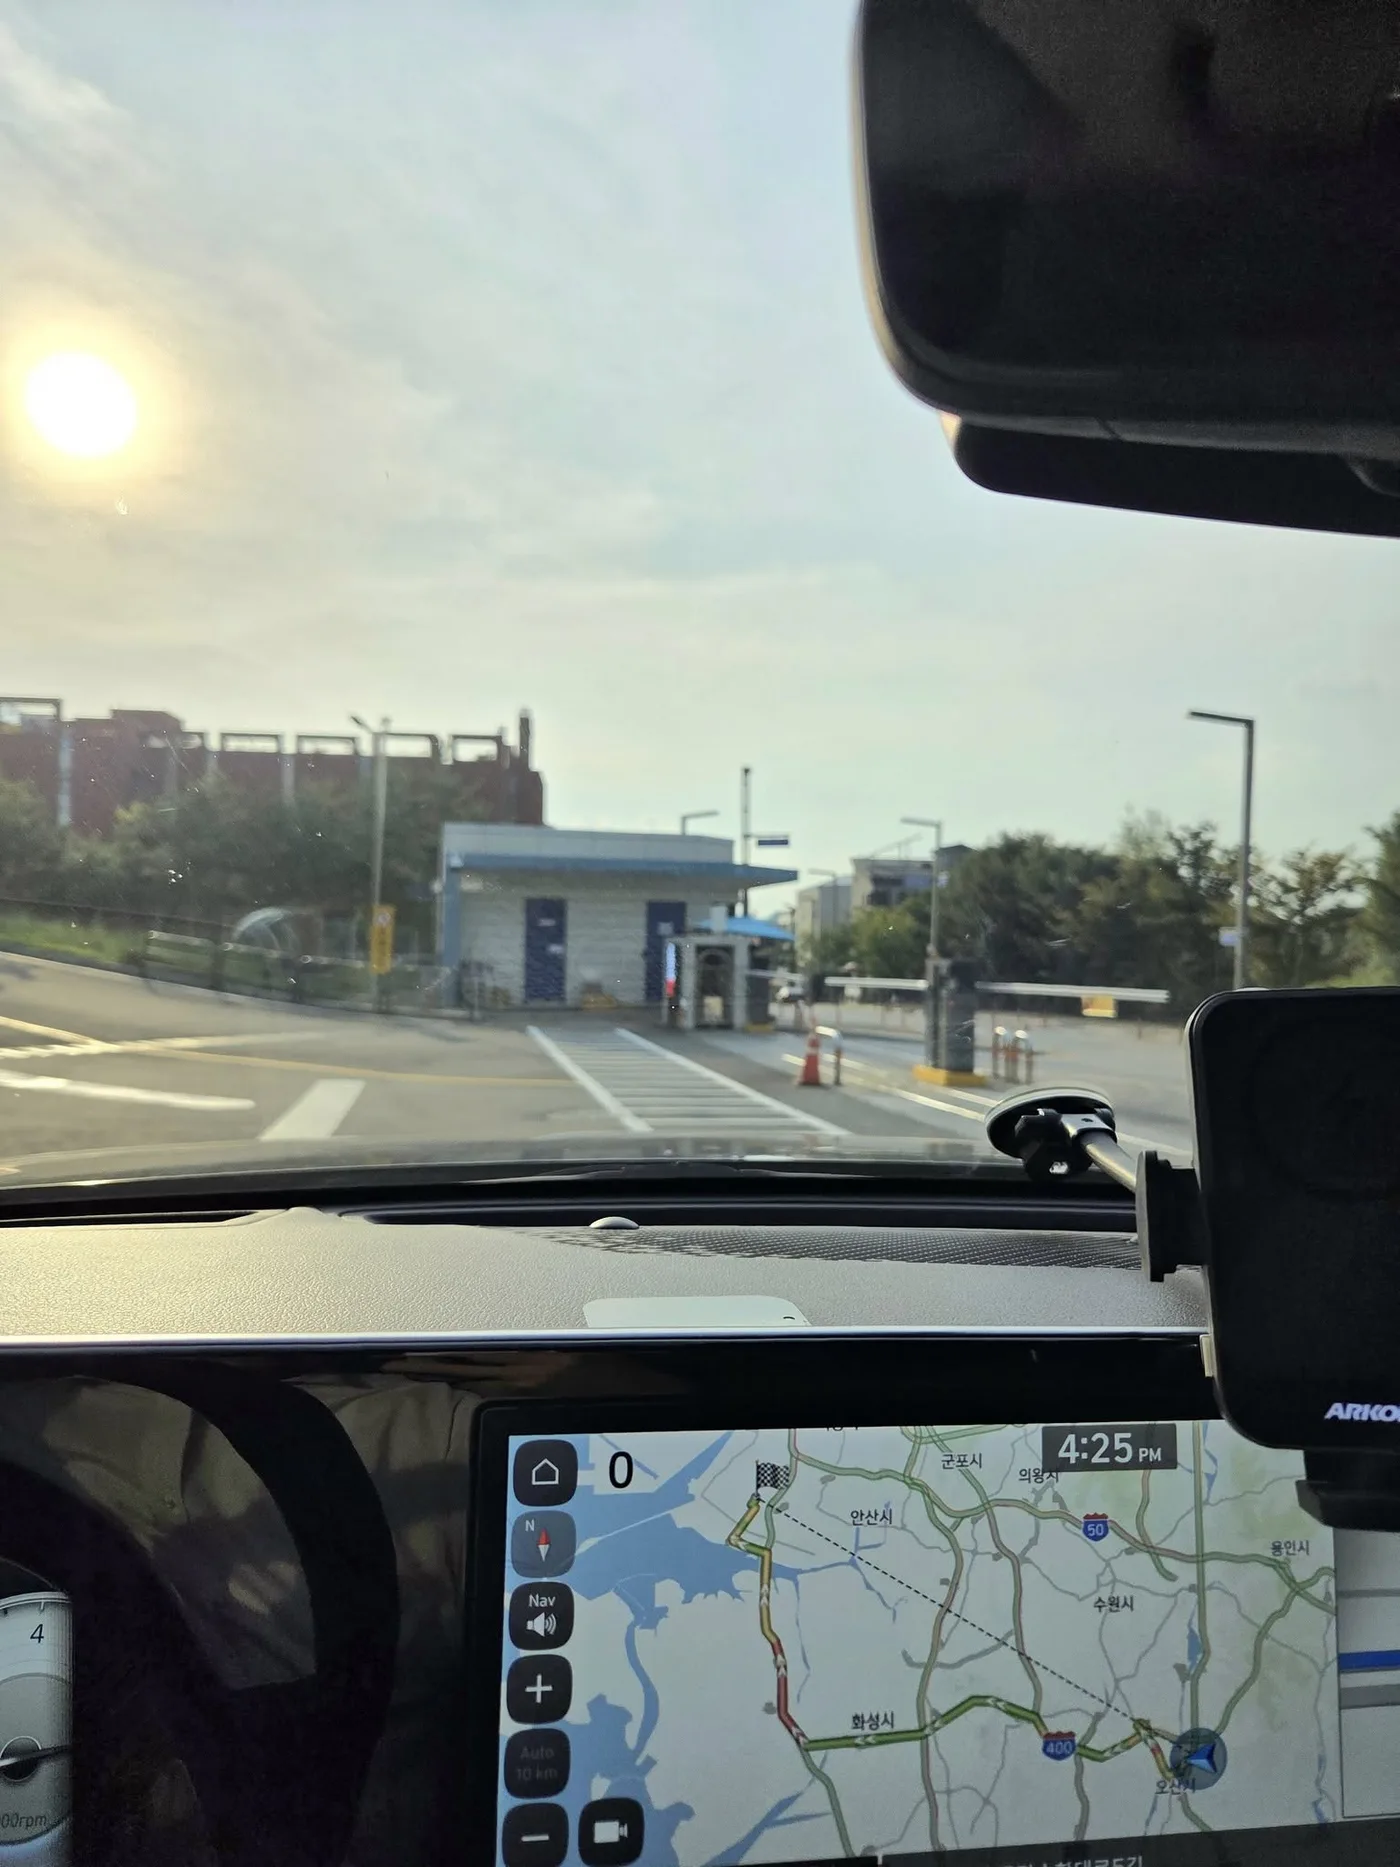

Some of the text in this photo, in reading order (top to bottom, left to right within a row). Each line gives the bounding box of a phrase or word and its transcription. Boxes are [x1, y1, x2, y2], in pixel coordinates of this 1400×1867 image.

[1324, 1402, 1400, 1422] ARKO
[1058, 1432, 1162, 1464] 4:25 PM
[608, 1451, 634, 1489] 0
[941, 1452, 983, 1470] 군포시
[1018, 1467, 1060, 1484] 의왕시
[524, 1519, 536, 1533] N
[850, 1508, 893, 1527] 안산시
[1087, 1523, 1105, 1538] 50
[1270, 1539, 1311, 1557] 용인시
[528, 1594, 556, 1608] Nav
[1093, 1595, 1135, 1613] 수원시
[29, 1623, 45, 1644] 4
[851, 1712, 896, 1731] 화성시
[520, 1746, 555, 1760] Auto
[1046, 1740, 1073, 1755] 400
[516, 1764, 558, 1781] 10 km
[1155, 1777, 1196, 1796] 오산시
